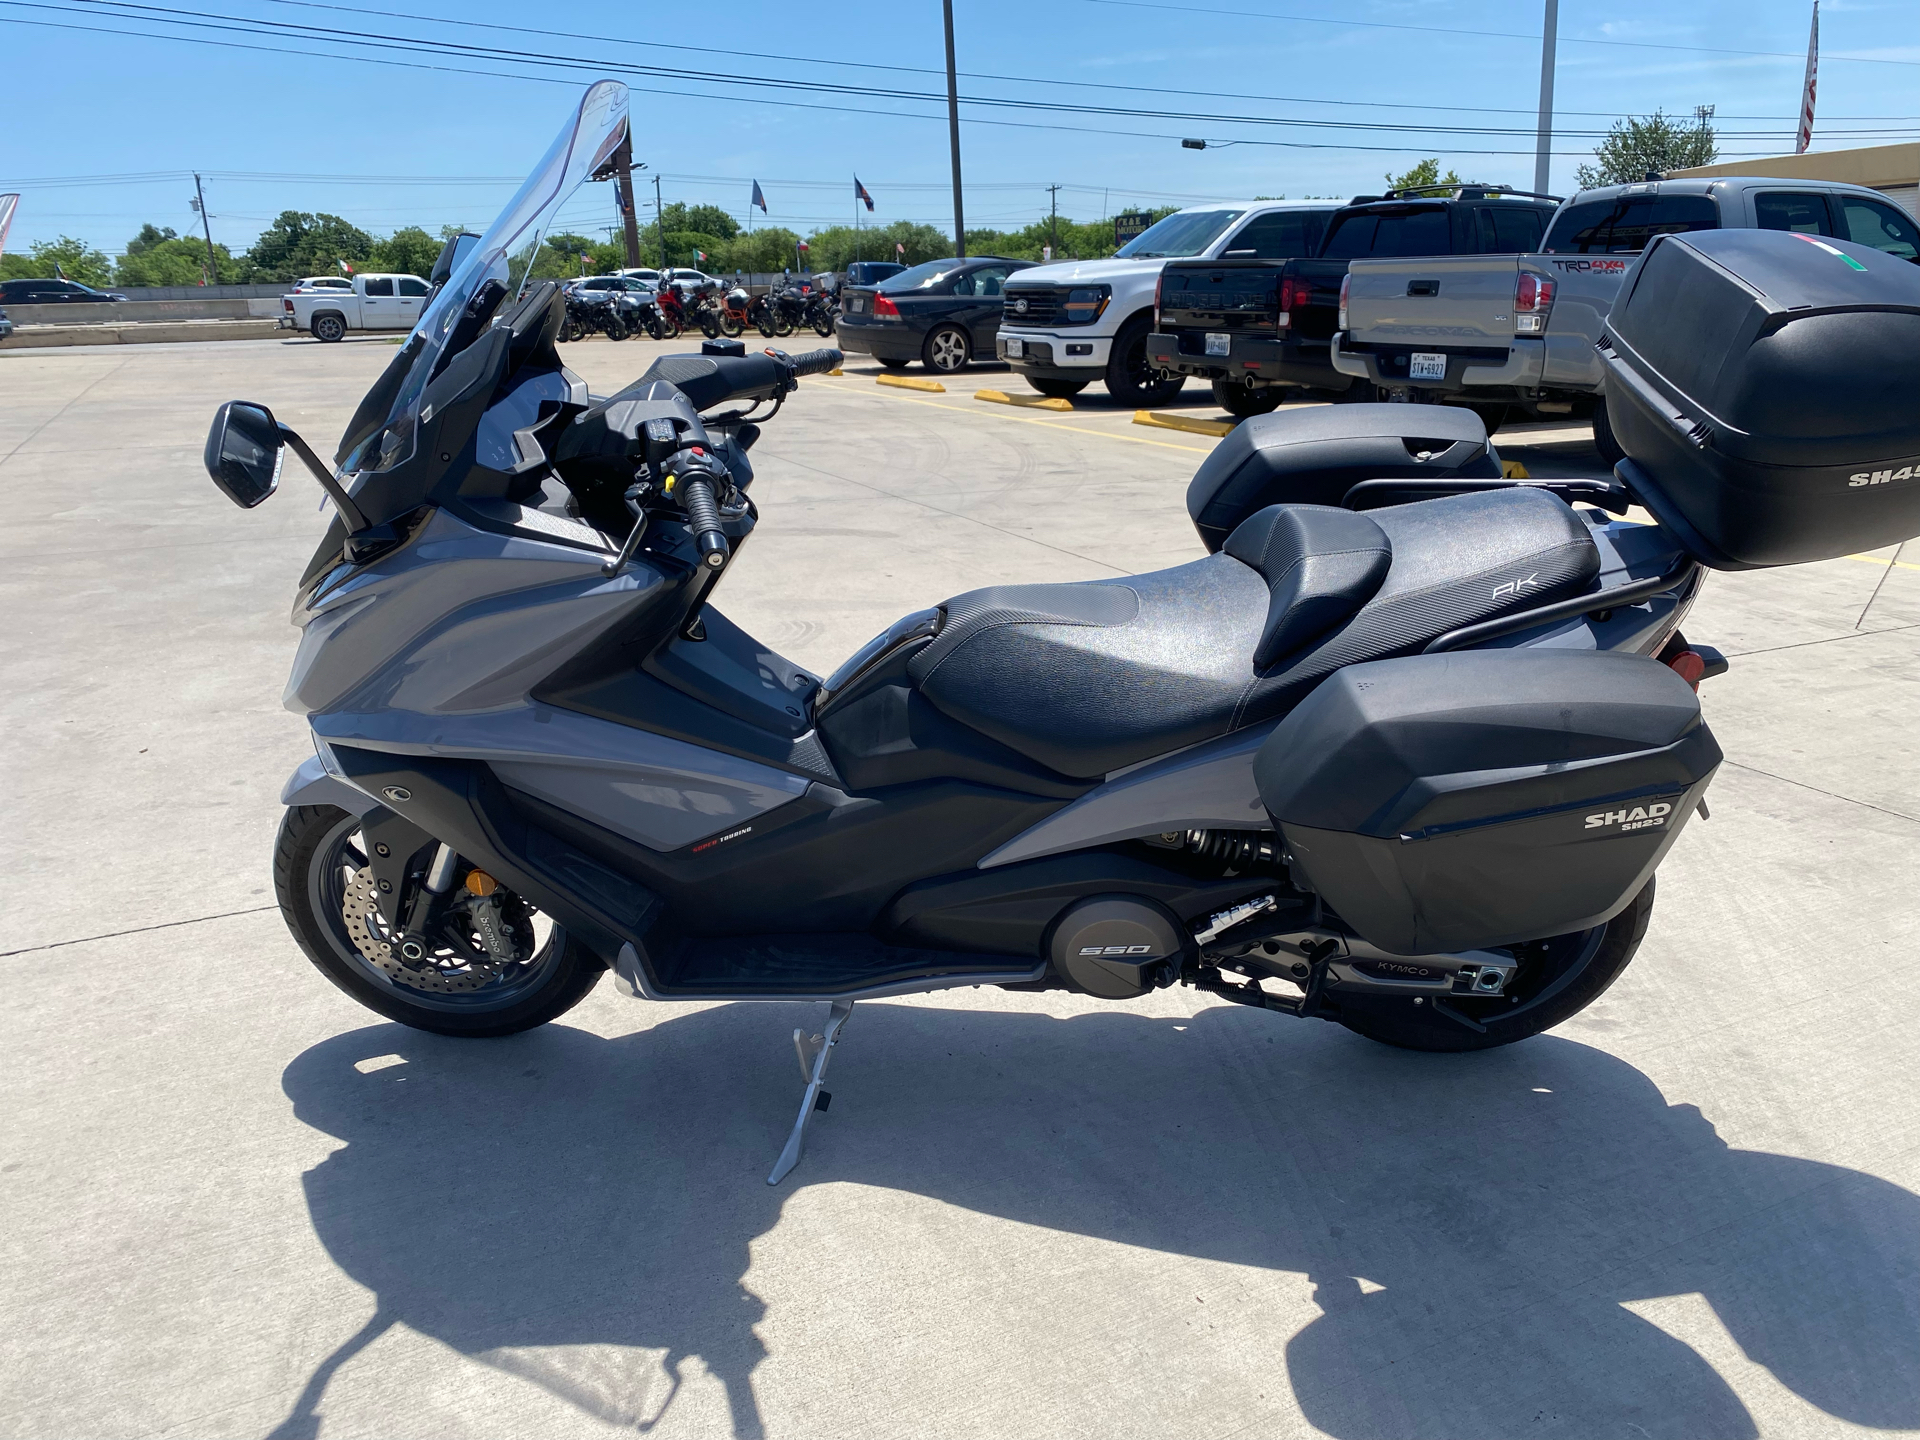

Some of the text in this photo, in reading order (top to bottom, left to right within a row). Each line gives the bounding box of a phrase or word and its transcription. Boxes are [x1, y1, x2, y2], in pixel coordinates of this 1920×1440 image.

[1492, 572, 1539, 601] AK
[1584, 802, 1672, 829] SHAD
[1621, 817, 1665, 831] SH23
[719, 826, 752, 843] TOURING
[479, 916, 501, 953] brembo
[1078, 944, 1152, 956] 550
[1377, 961, 1429, 976] KYMCO
